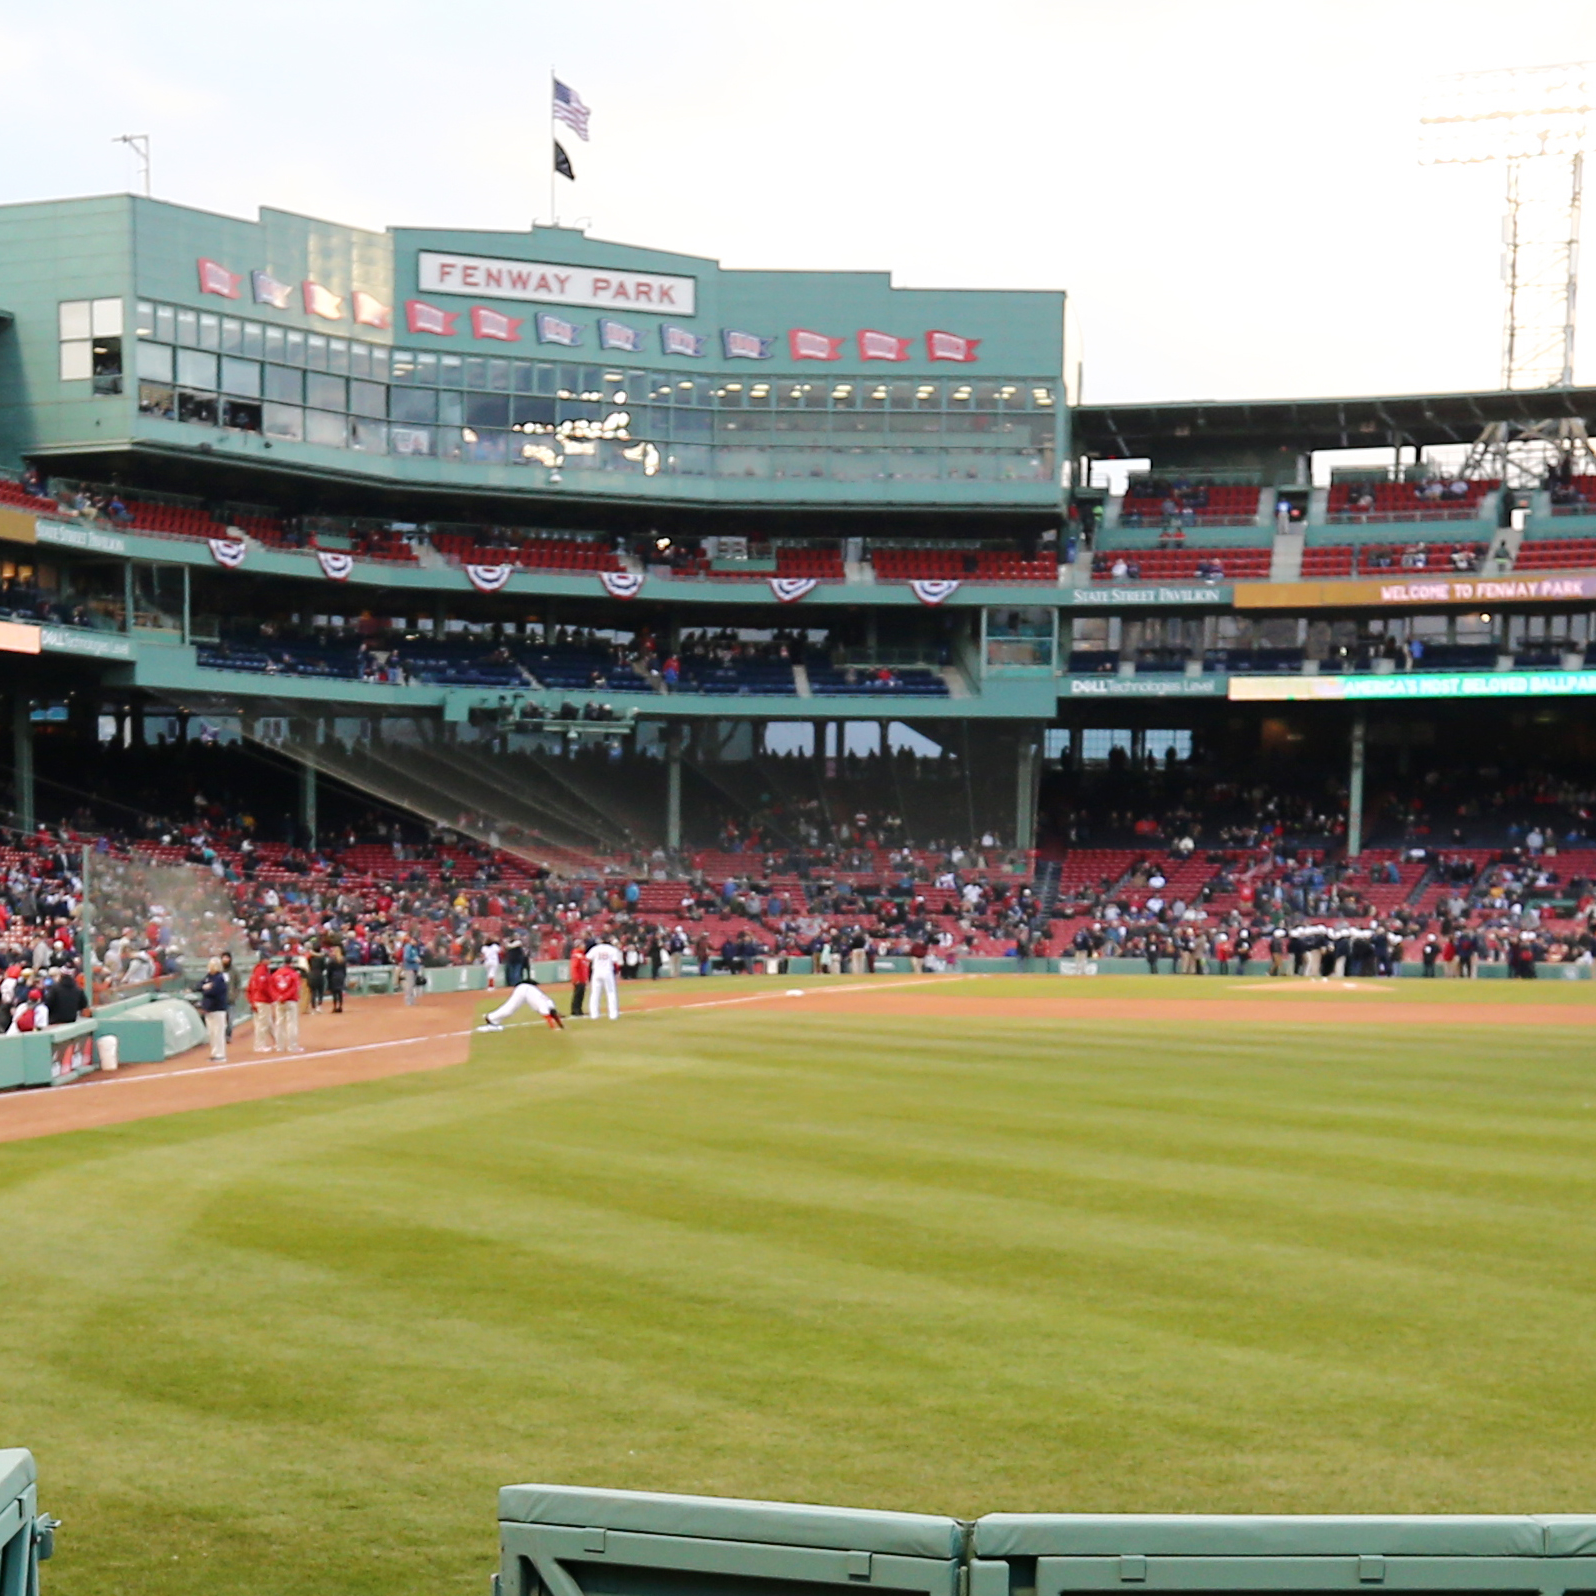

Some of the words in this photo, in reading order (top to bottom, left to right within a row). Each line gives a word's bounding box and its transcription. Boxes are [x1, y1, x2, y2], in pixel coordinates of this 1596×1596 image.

[440, 262, 571, 295] FENWAY
[592, 277, 676, 305] PARK
[1073, 587, 1109, 603] STATE
[1111, 587, 1155, 603] STREET
[1158, 586, 1220, 602] PAVILION
[1381, 582, 1449, 601] WELCOME
[1453, 582, 1473, 600] TO
[1476, 580, 1537, 599] FENWAY
[1541, 579, 1584, 597] PARK
[1071, 680, 1107, 693] DELL
[1107, 679, 1180, 696] Technologies
[1184, 678, 1215, 693] Level
[1344, 679, 1417, 698] AMERICA'S
[1419, 678, 1460, 696] MOST
